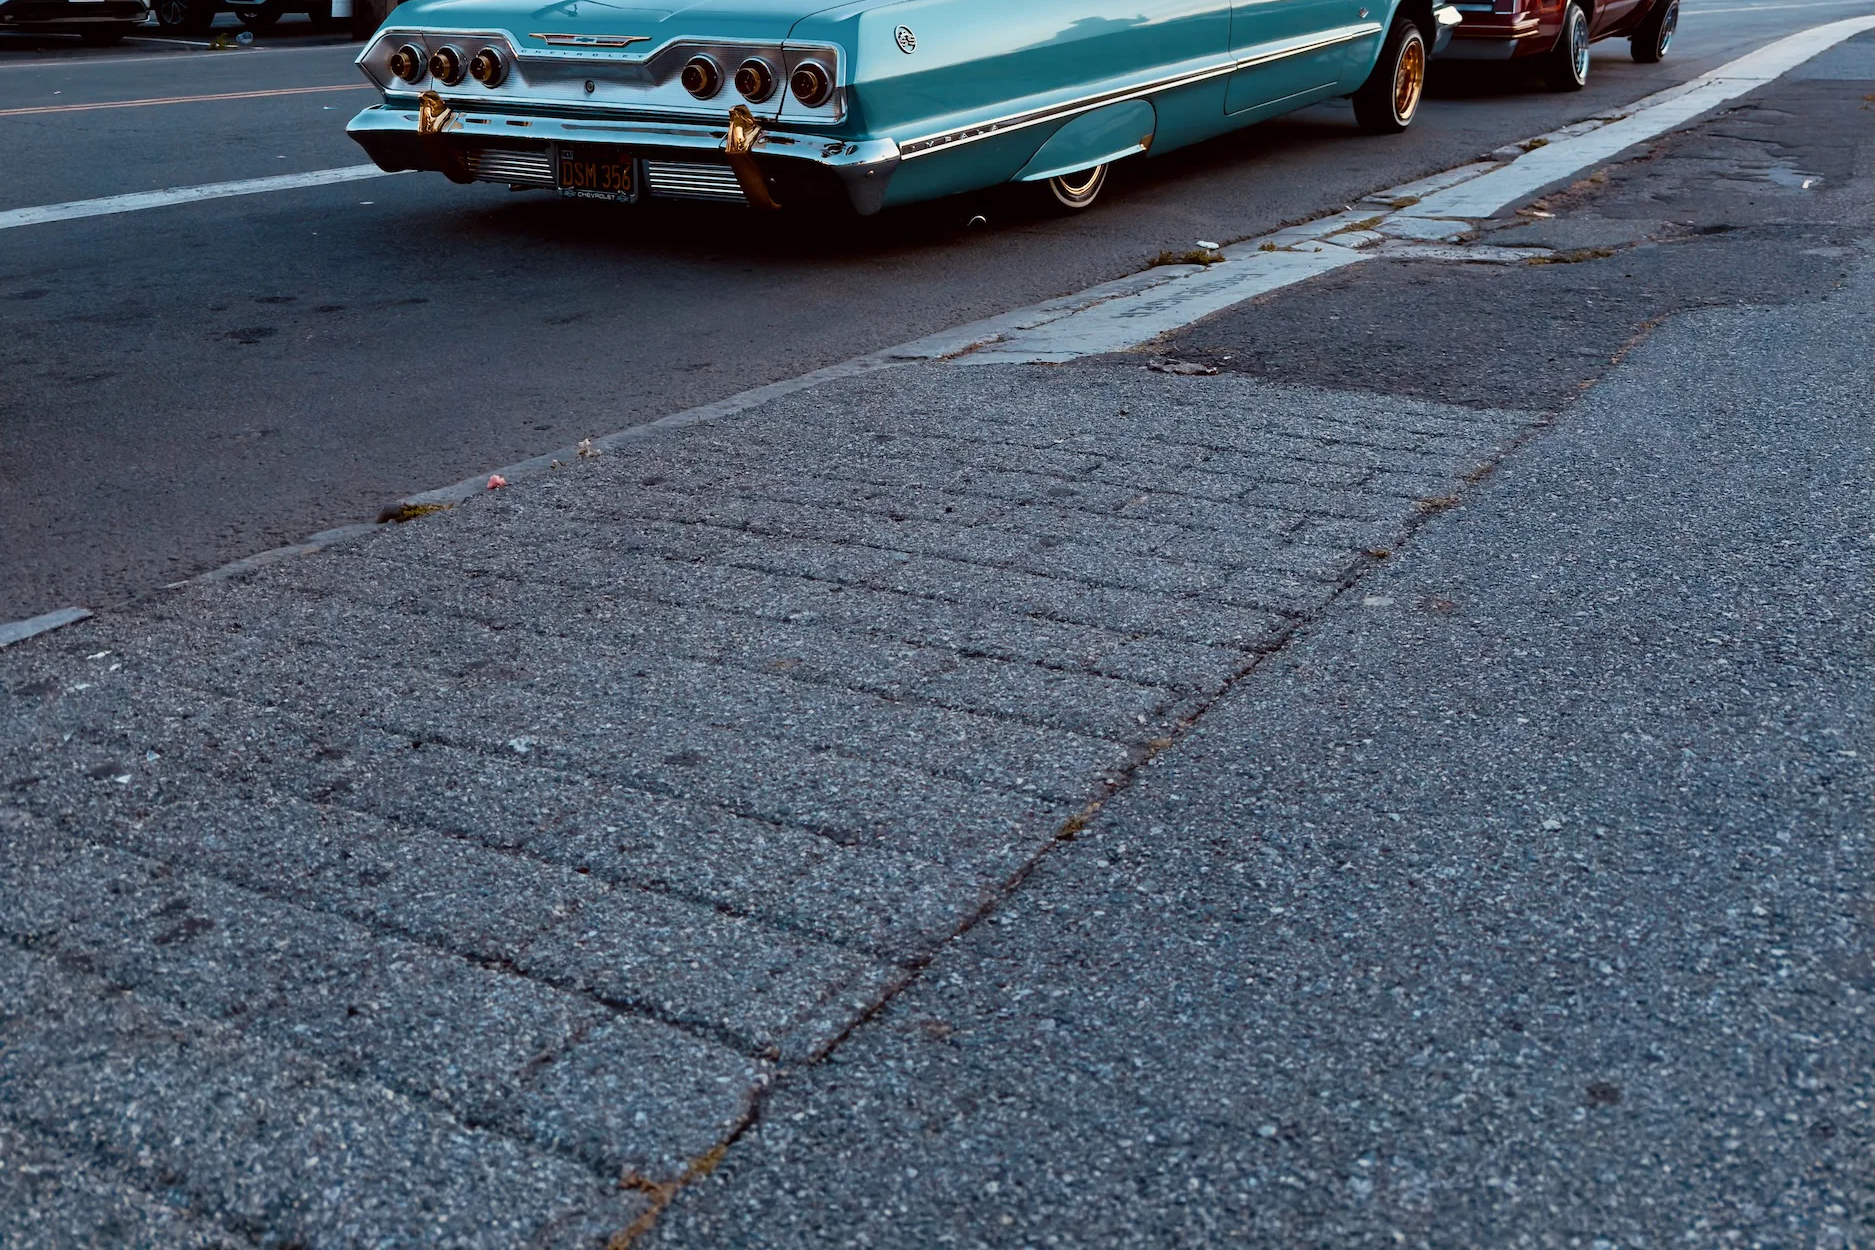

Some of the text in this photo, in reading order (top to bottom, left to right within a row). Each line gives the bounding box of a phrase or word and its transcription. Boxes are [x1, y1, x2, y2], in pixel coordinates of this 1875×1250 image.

[520, 49, 644, 59] CHEVROLET
[562, 161, 631, 191] DSM 356
[577, 192, 616, 200] CHEVROLET
